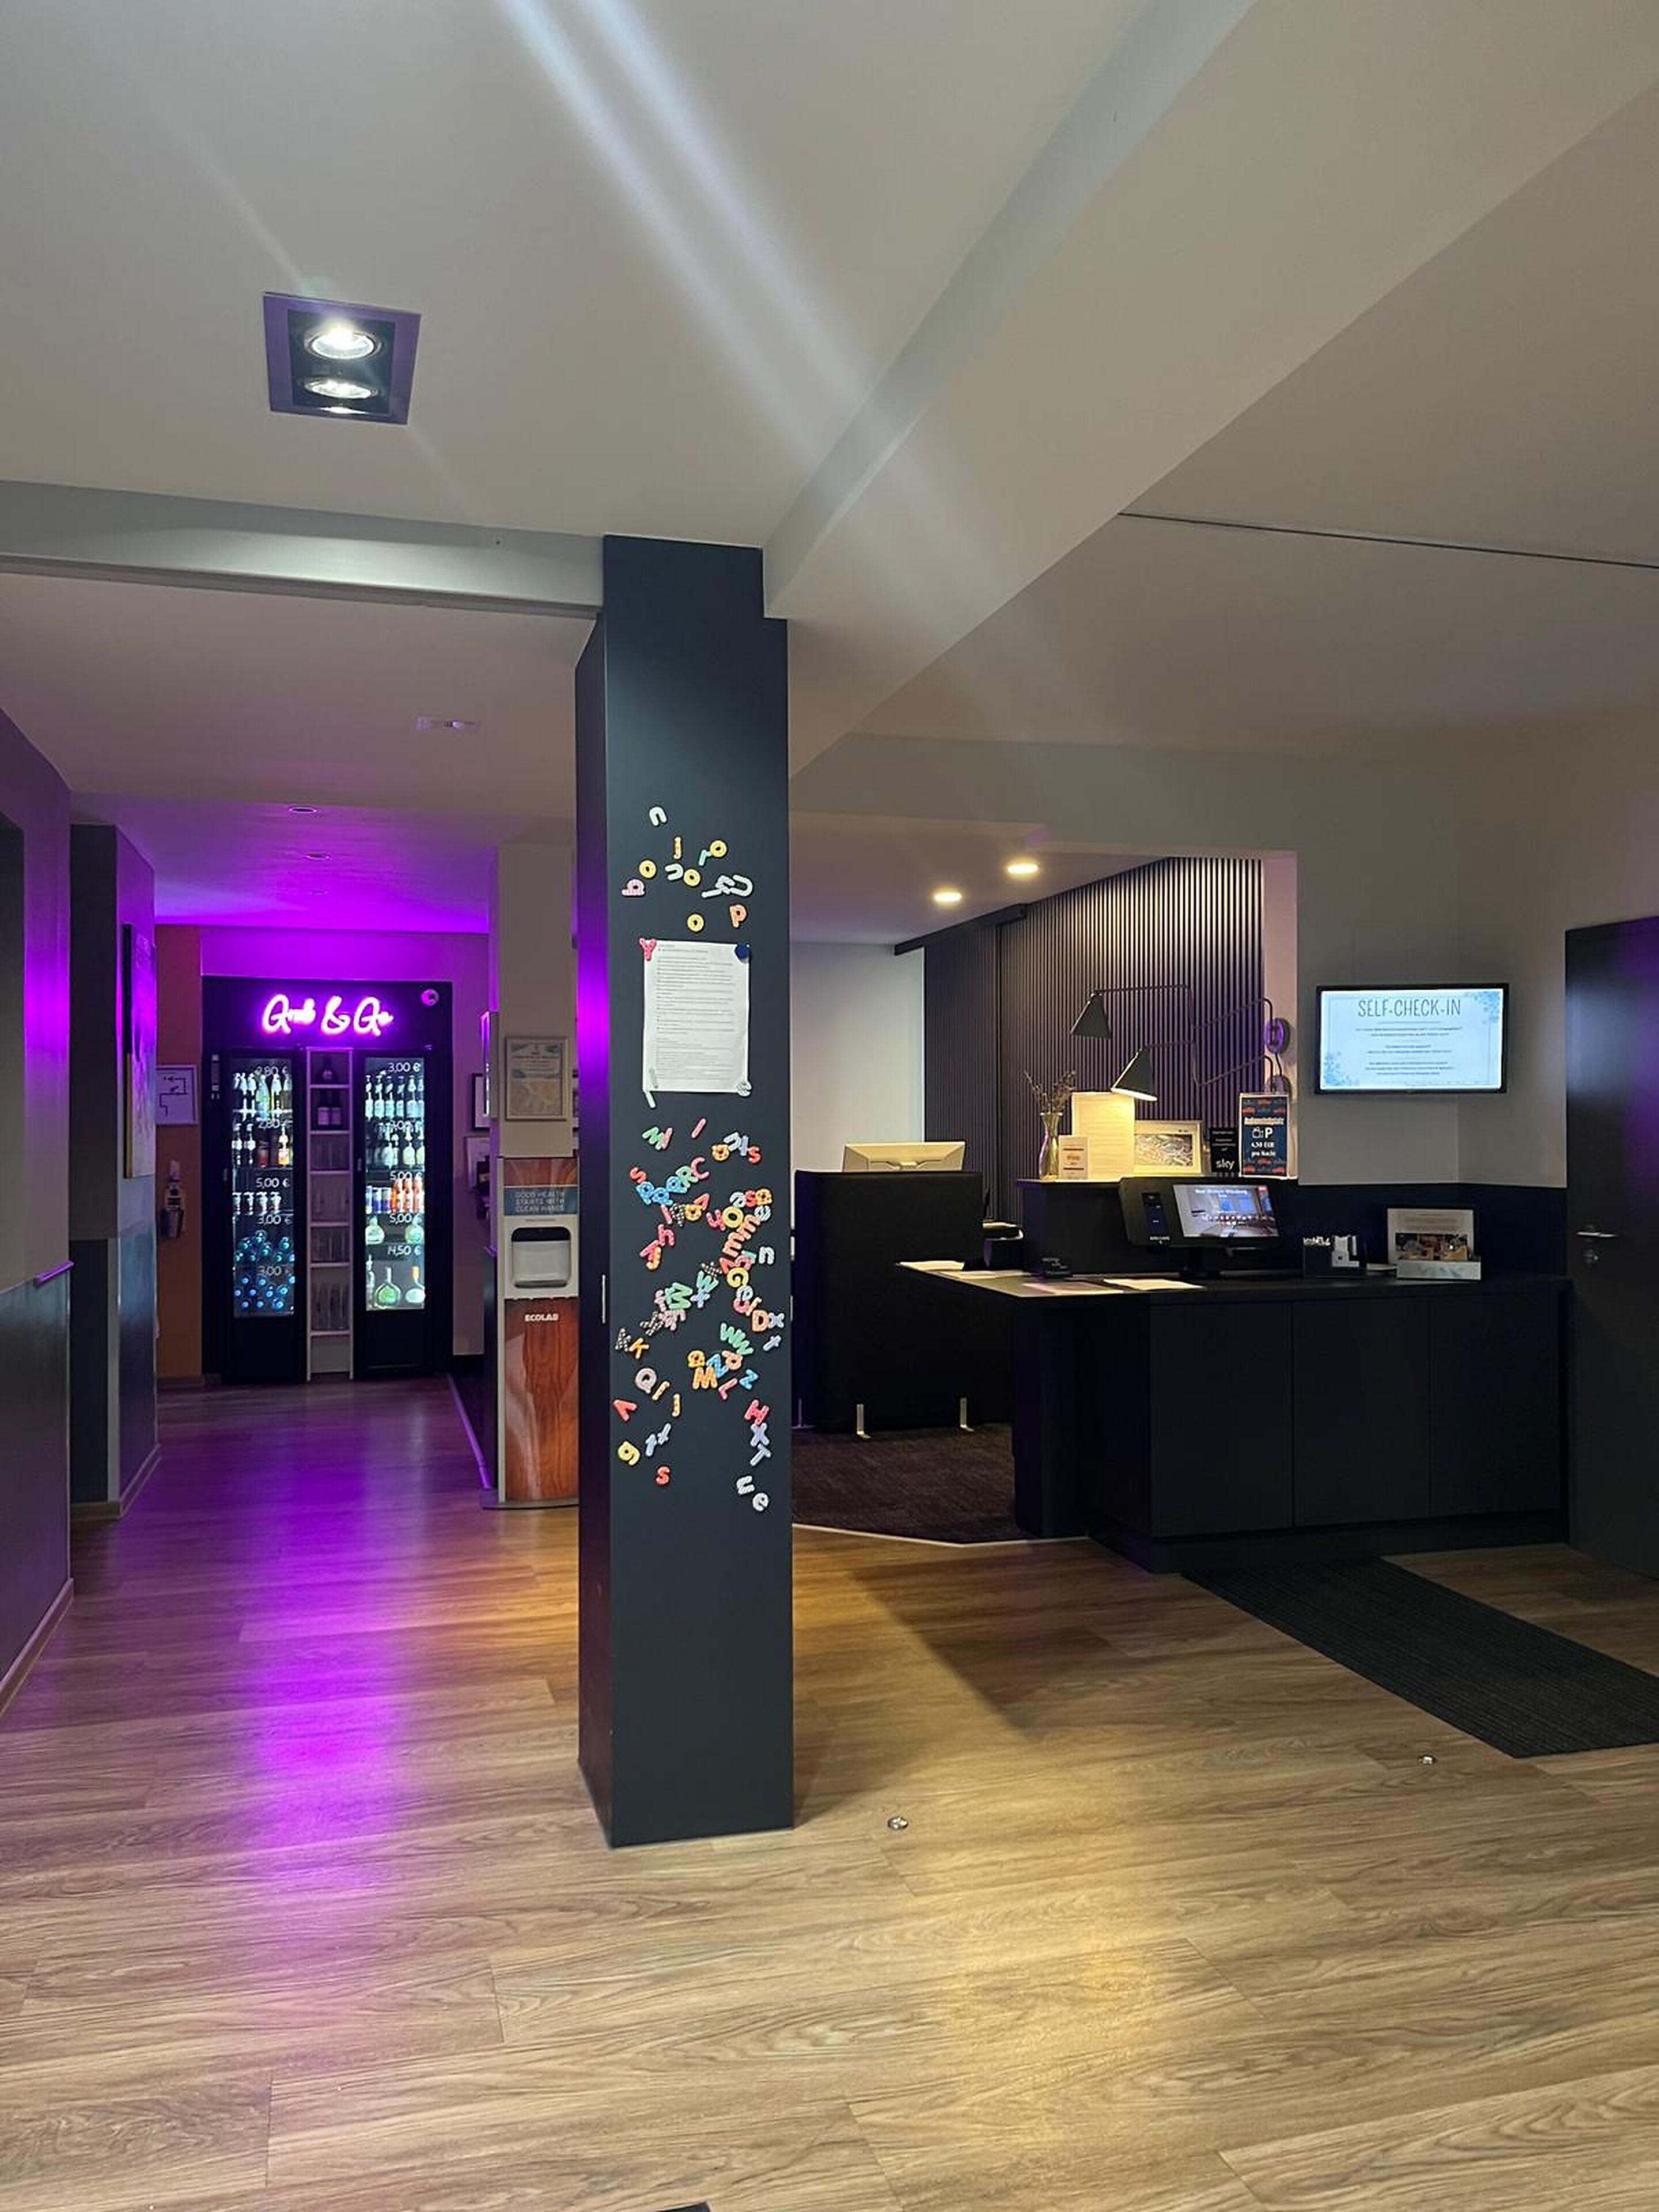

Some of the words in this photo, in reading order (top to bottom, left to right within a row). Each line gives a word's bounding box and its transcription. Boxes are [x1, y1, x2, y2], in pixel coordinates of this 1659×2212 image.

[321, 995, 351, 1034] &
[1264, 1126, 1273, 1139] P
[1215, 1158, 1235, 1171] sky
[525, 1313, 559, 1322] ECOLAB
